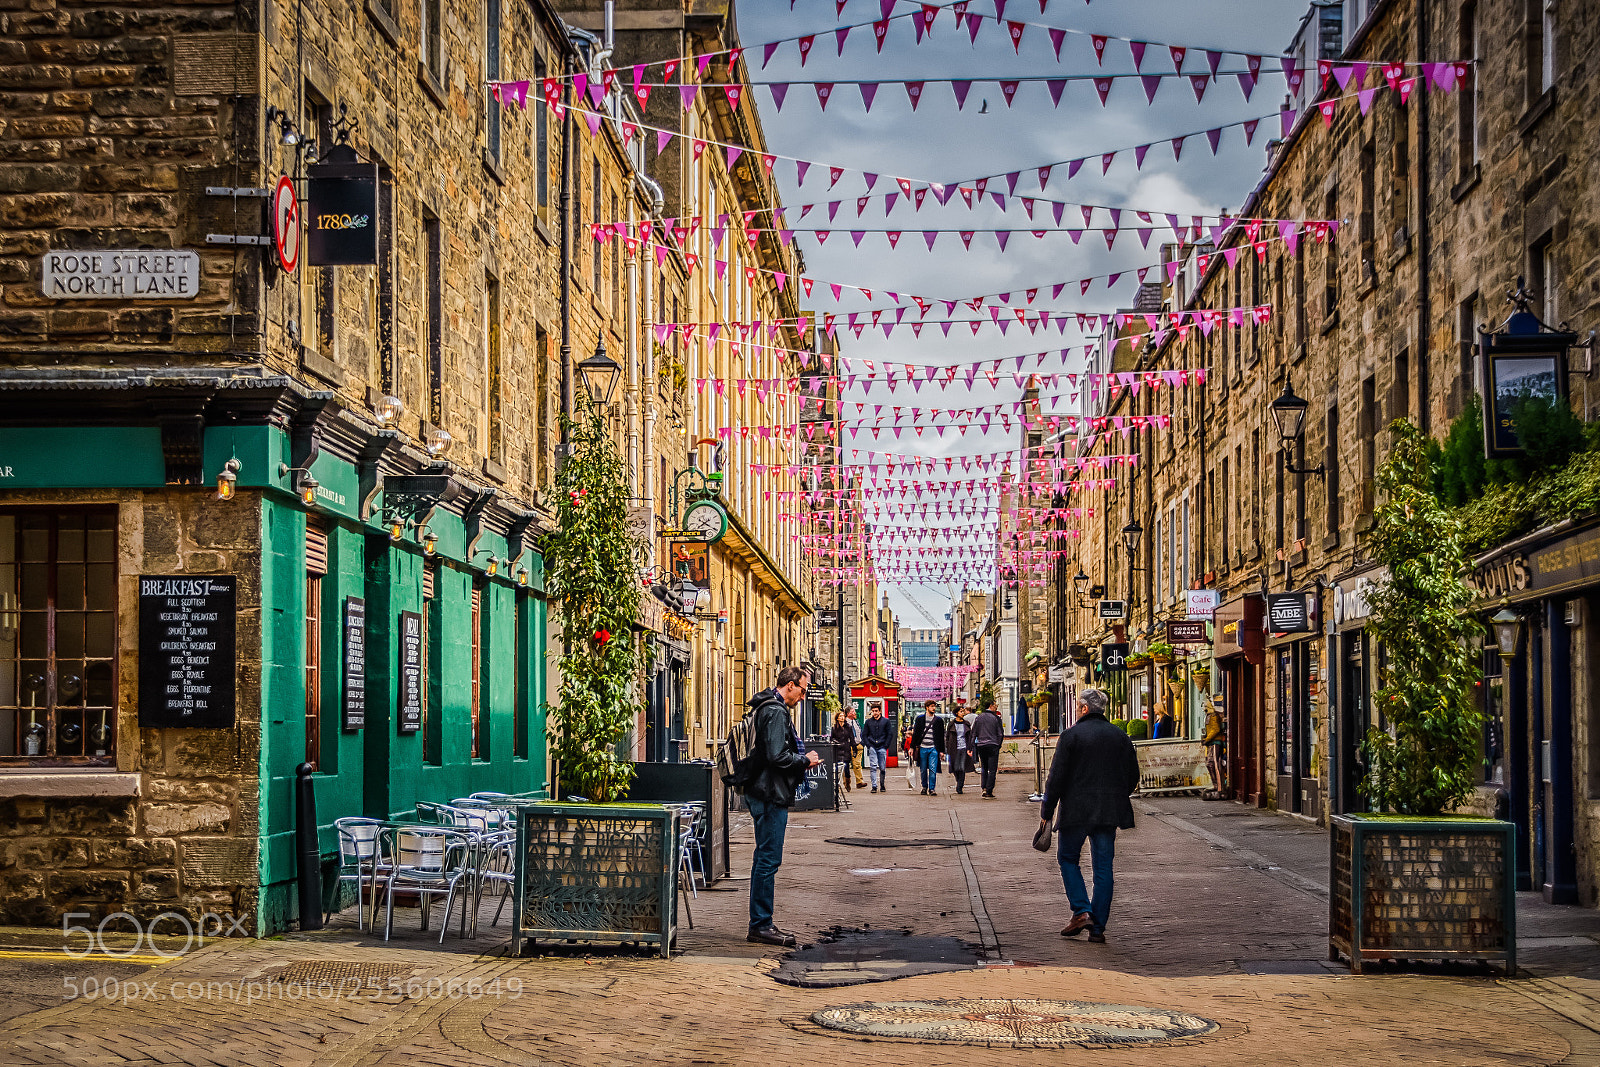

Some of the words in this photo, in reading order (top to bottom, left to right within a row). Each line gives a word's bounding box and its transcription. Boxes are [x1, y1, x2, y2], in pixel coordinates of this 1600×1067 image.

[317, 214, 352, 229] 1780
[50, 255, 102, 274] ROSE
[112, 255, 191, 274] STREET
[53, 276, 125, 295] NORTH
[133, 276, 189, 295] LANE
[1501, 419, 1518, 427] SC
[1537, 550, 1563, 575] ROSE
[141, 579, 214, 596] BREAKFAST
[167, 598, 179, 607] FULL
[180, 598, 206, 607] SCOTTISH
[1275, 608, 1301, 619] MBE
[168, 627, 187, 636] SMOKED
[189, 627, 208, 636] SALMON
[170, 656, 185, 664] EGGS
[187, 656, 210, 664] BENEDICT
[1106, 650, 1125, 665] dh
[171, 670, 185, 679] EGGS
[186, 670, 205, 679] ROYALE
[166, 685, 180, 693] EGGS
[183, 685, 212, 693] FLORENTINE
[168, 700, 194, 708] BREAKFAST
[196, 700, 208, 708] ROLL
